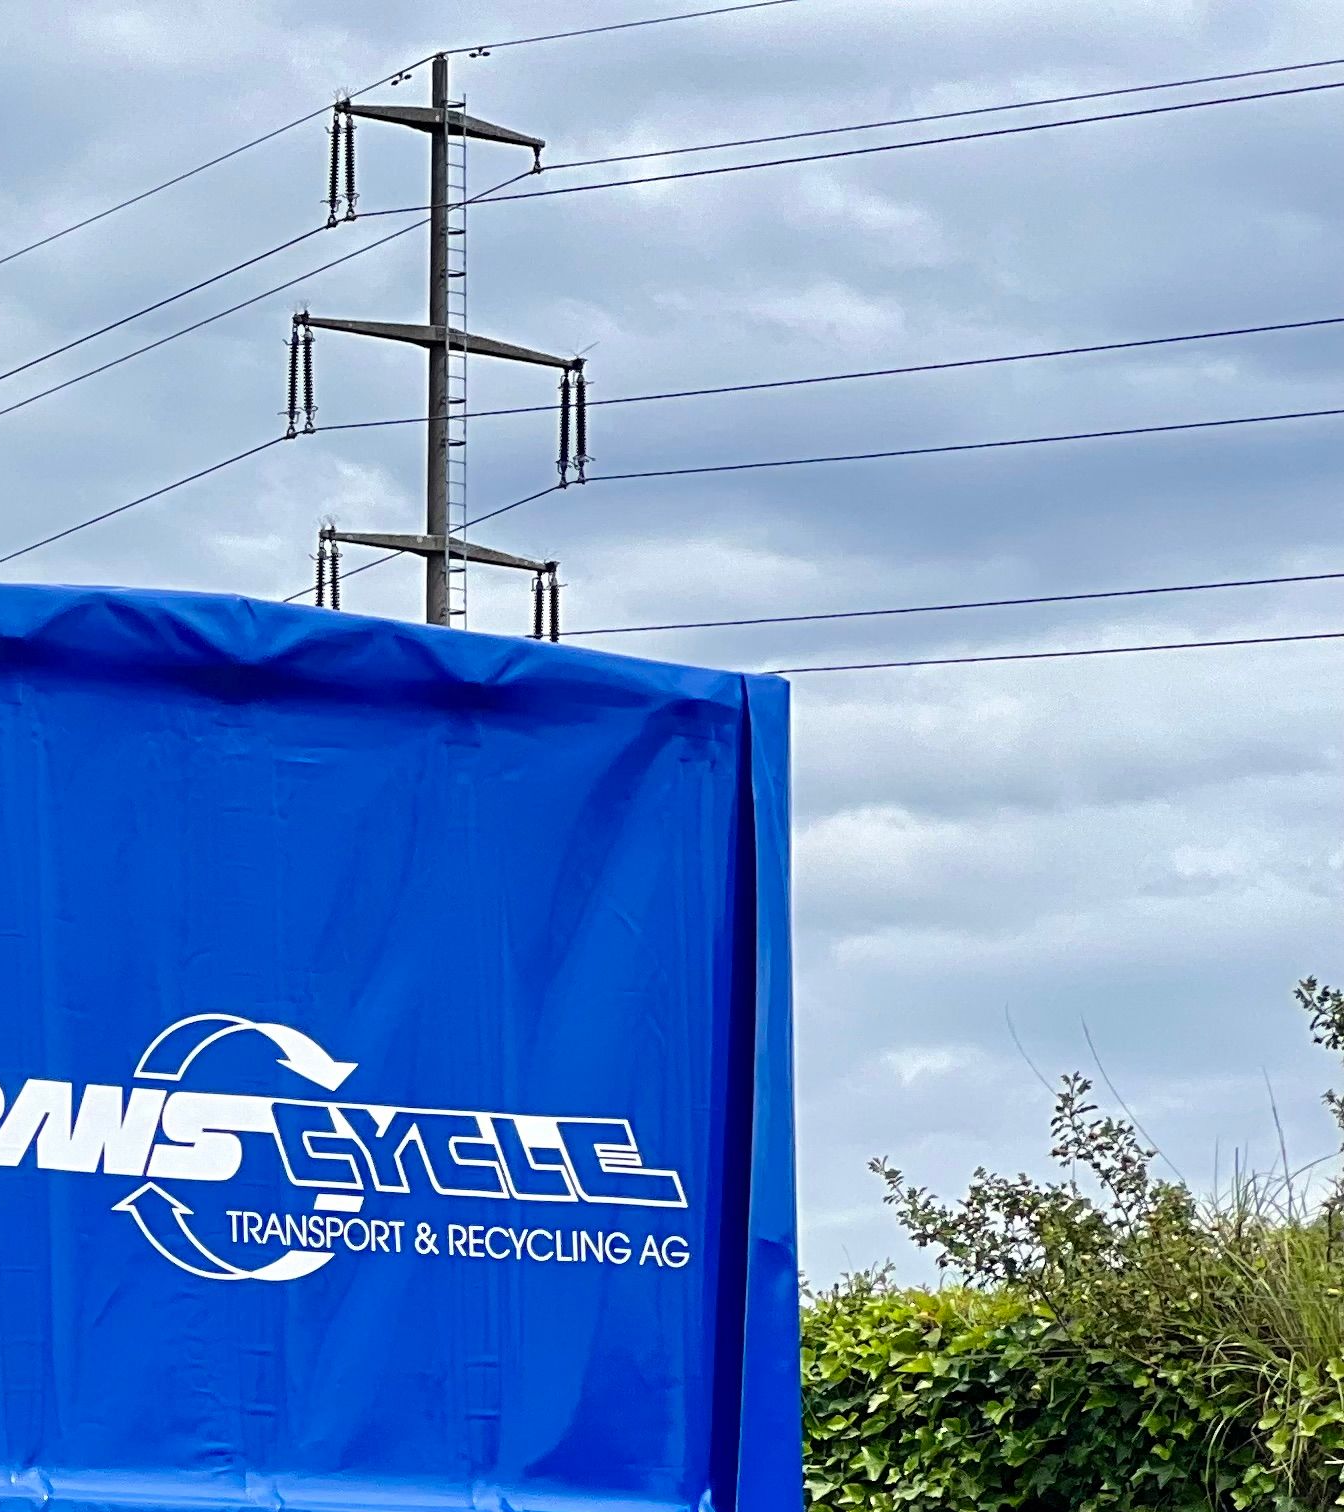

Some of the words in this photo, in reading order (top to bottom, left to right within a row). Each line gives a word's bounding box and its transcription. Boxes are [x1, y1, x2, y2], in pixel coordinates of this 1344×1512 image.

[226, 1210, 405, 1253] TRANSPORT
[414, 1222, 440, 1255] &
[448, 1224, 632, 1265] RECYCLING
[639, 1234, 690, 1268] AG
